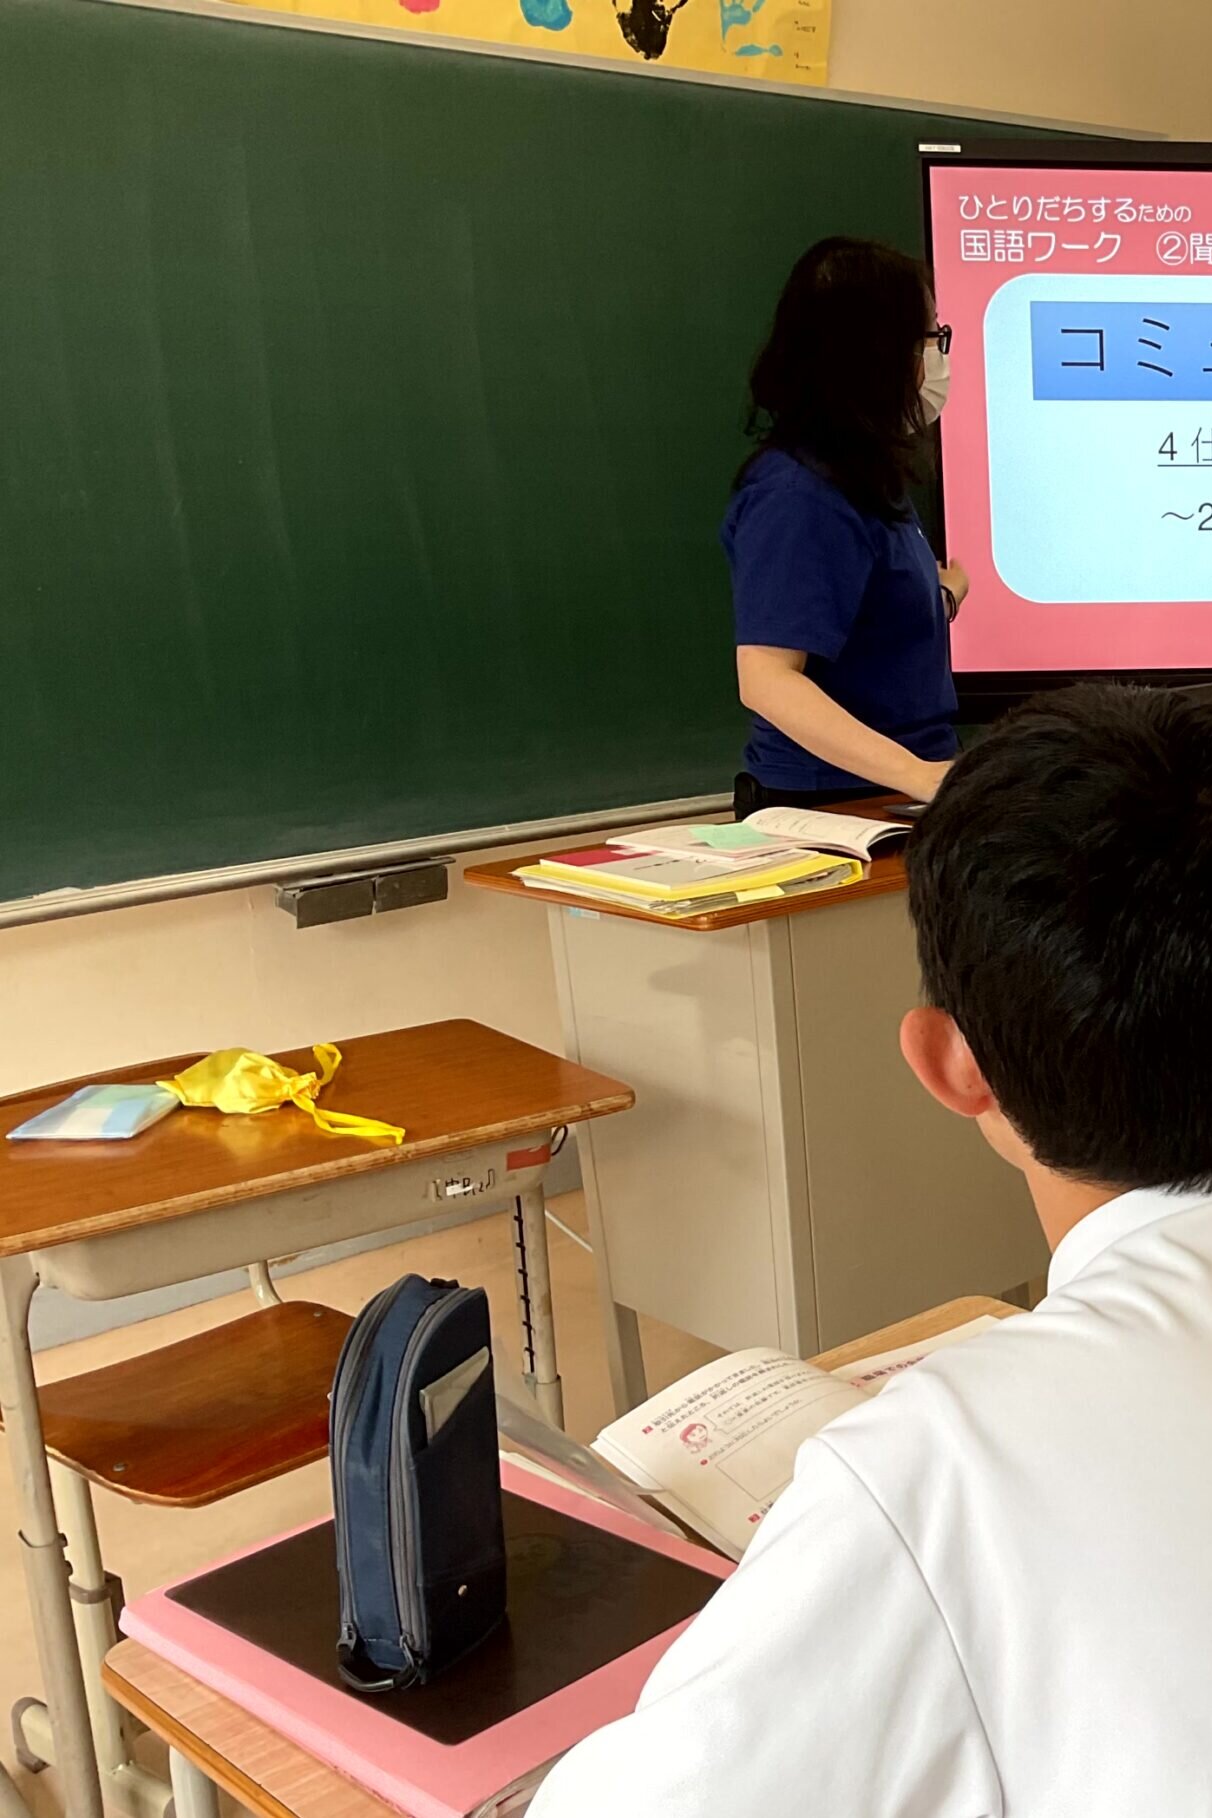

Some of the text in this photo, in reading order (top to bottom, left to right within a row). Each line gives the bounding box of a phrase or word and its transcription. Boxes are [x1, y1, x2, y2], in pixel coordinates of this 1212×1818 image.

[958, 194, 1192, 223] ひとりだちするための
[960, 229, 1121, 262] 国語ワーク
